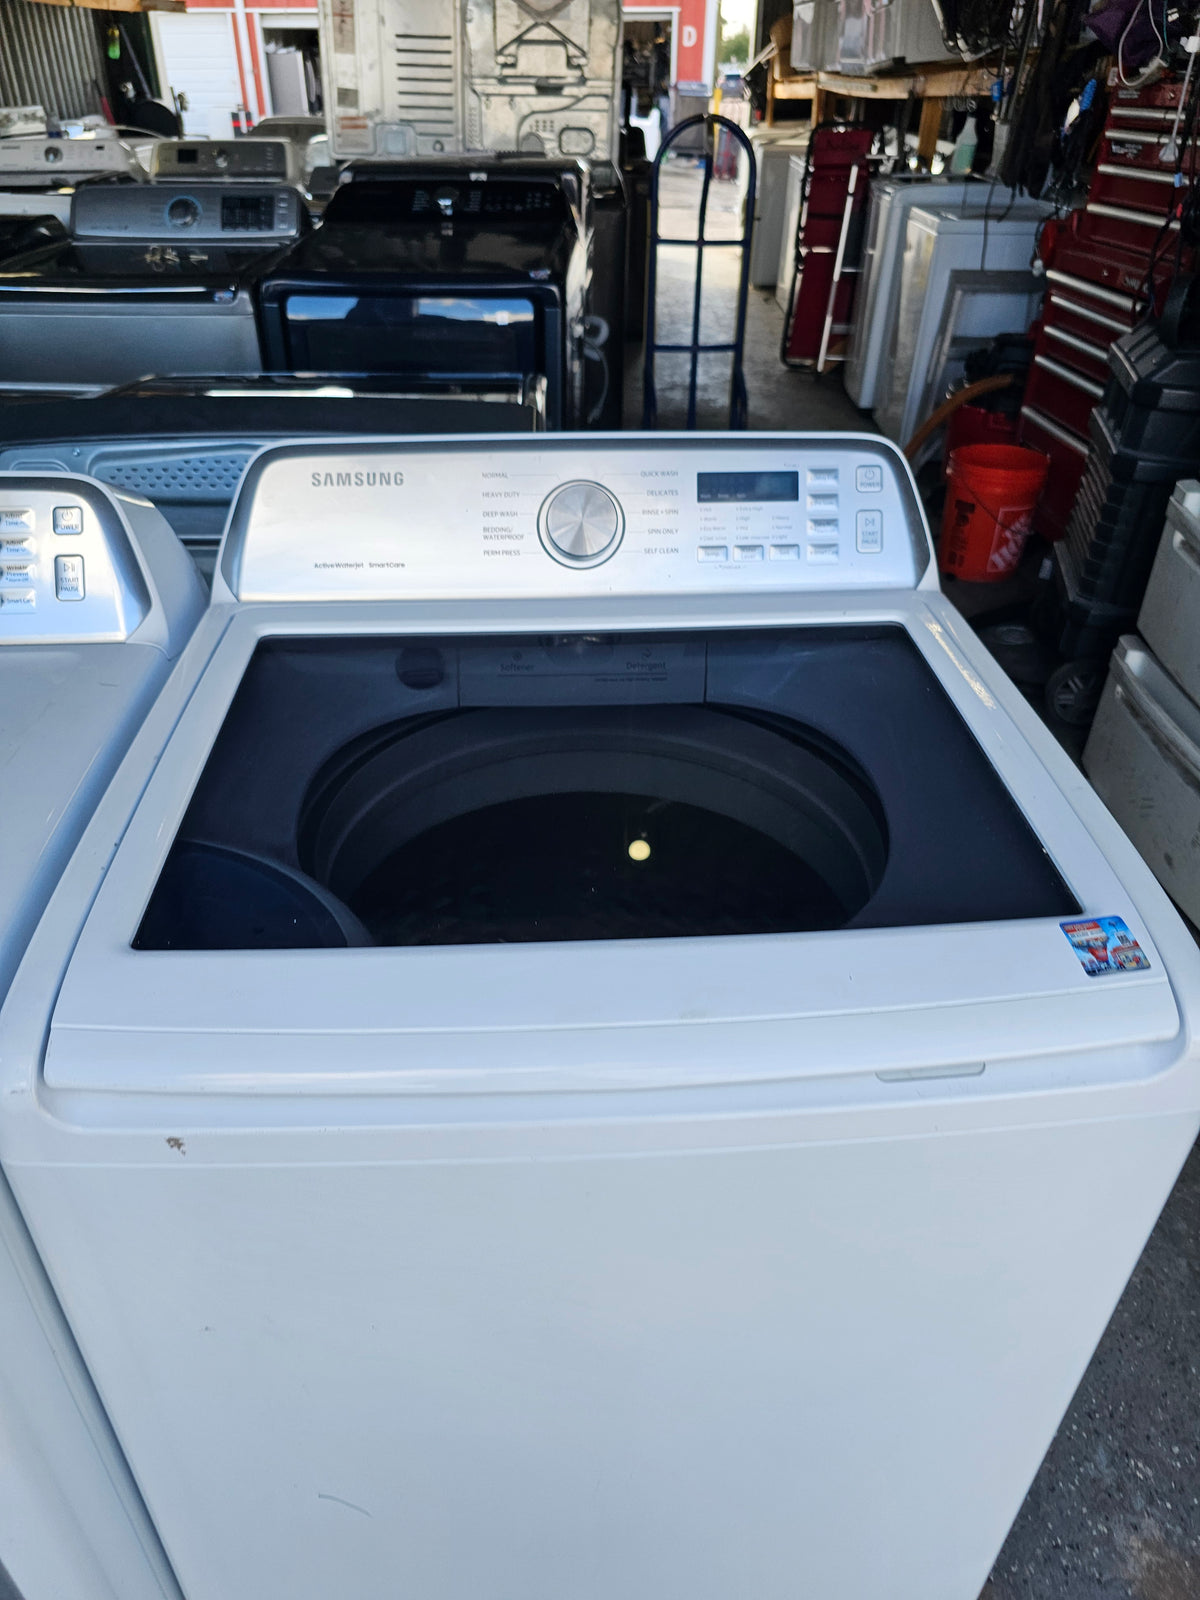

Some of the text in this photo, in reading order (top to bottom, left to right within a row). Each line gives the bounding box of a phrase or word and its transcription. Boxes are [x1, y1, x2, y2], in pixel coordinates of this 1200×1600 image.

[682, 25, 697, 48] D
[311, 471, 405, 487] SAMSUNG
[500, 663, 534, 672] Softener
[625, 661, 667, 672] Detergent
